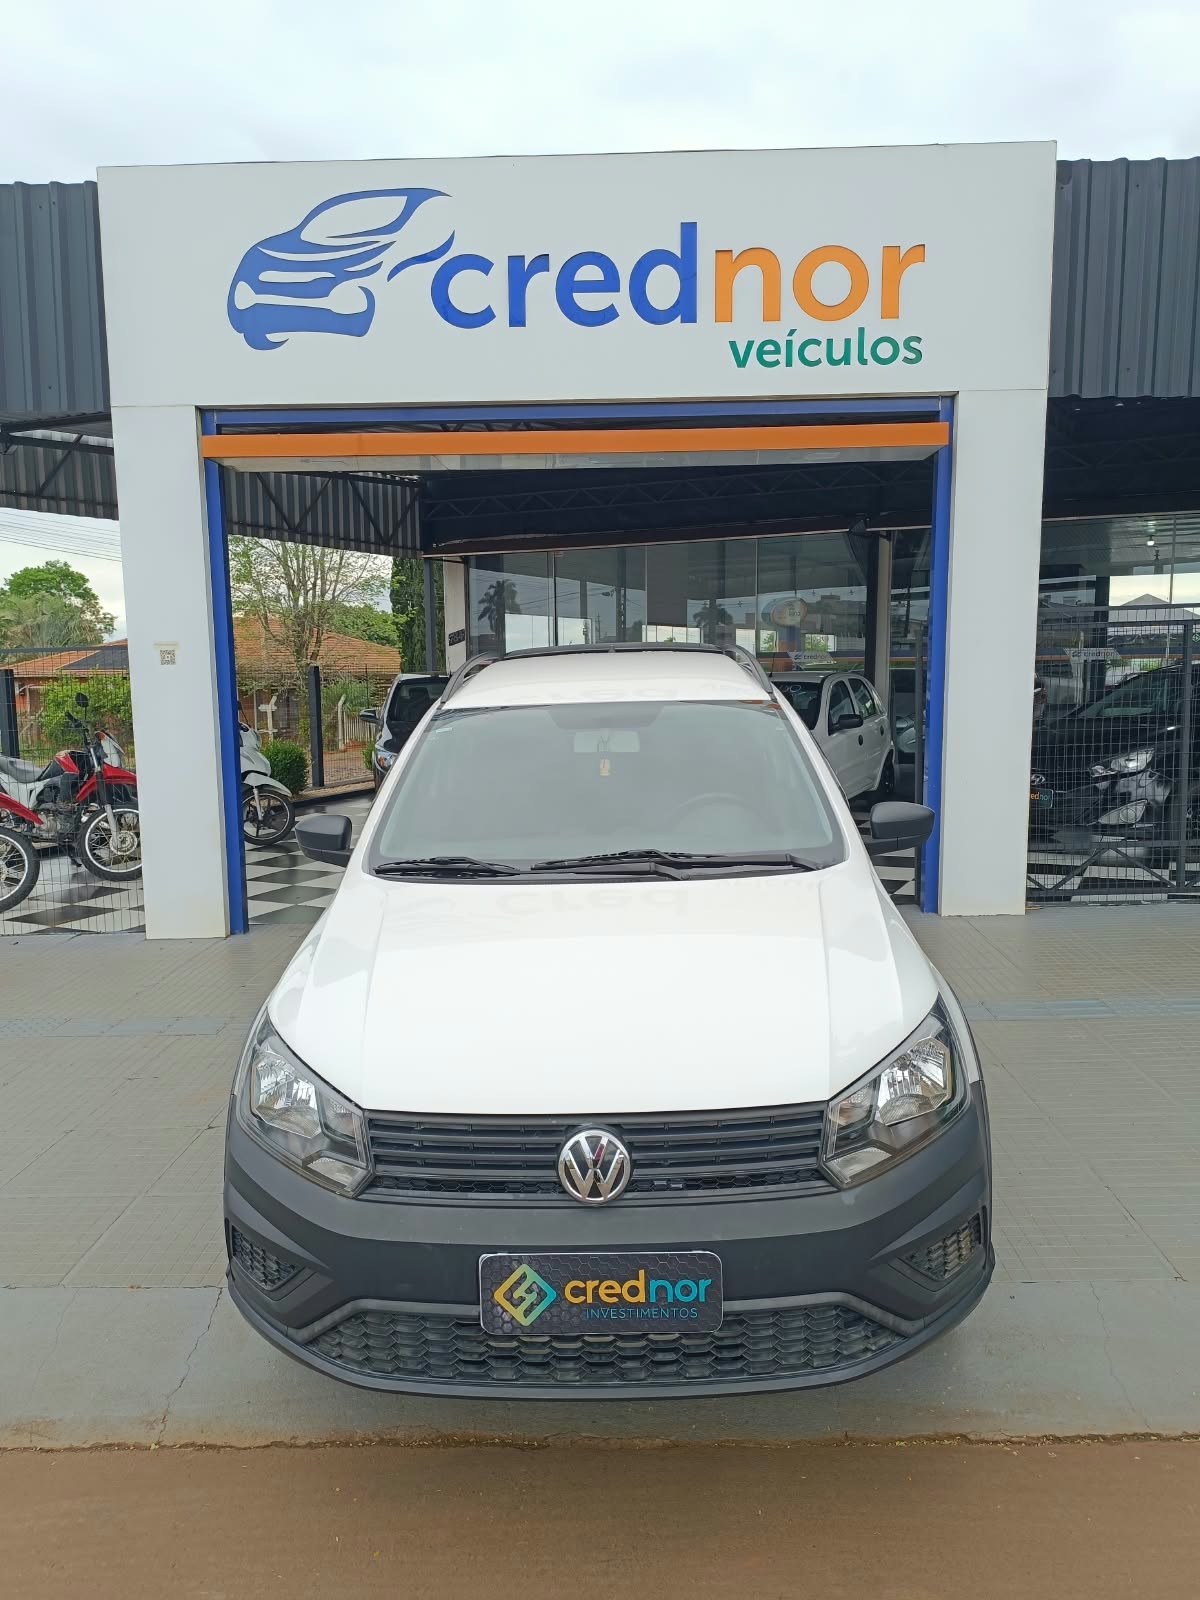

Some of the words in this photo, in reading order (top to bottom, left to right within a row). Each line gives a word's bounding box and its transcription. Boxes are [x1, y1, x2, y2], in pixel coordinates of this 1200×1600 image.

[431, 221, 926, 329] crednor
[728, 327, 924, 369] veículos
[564, 1269, 712, 1304] crednor
[586, 1307, 698, 1320] INVESTIMENTOS
